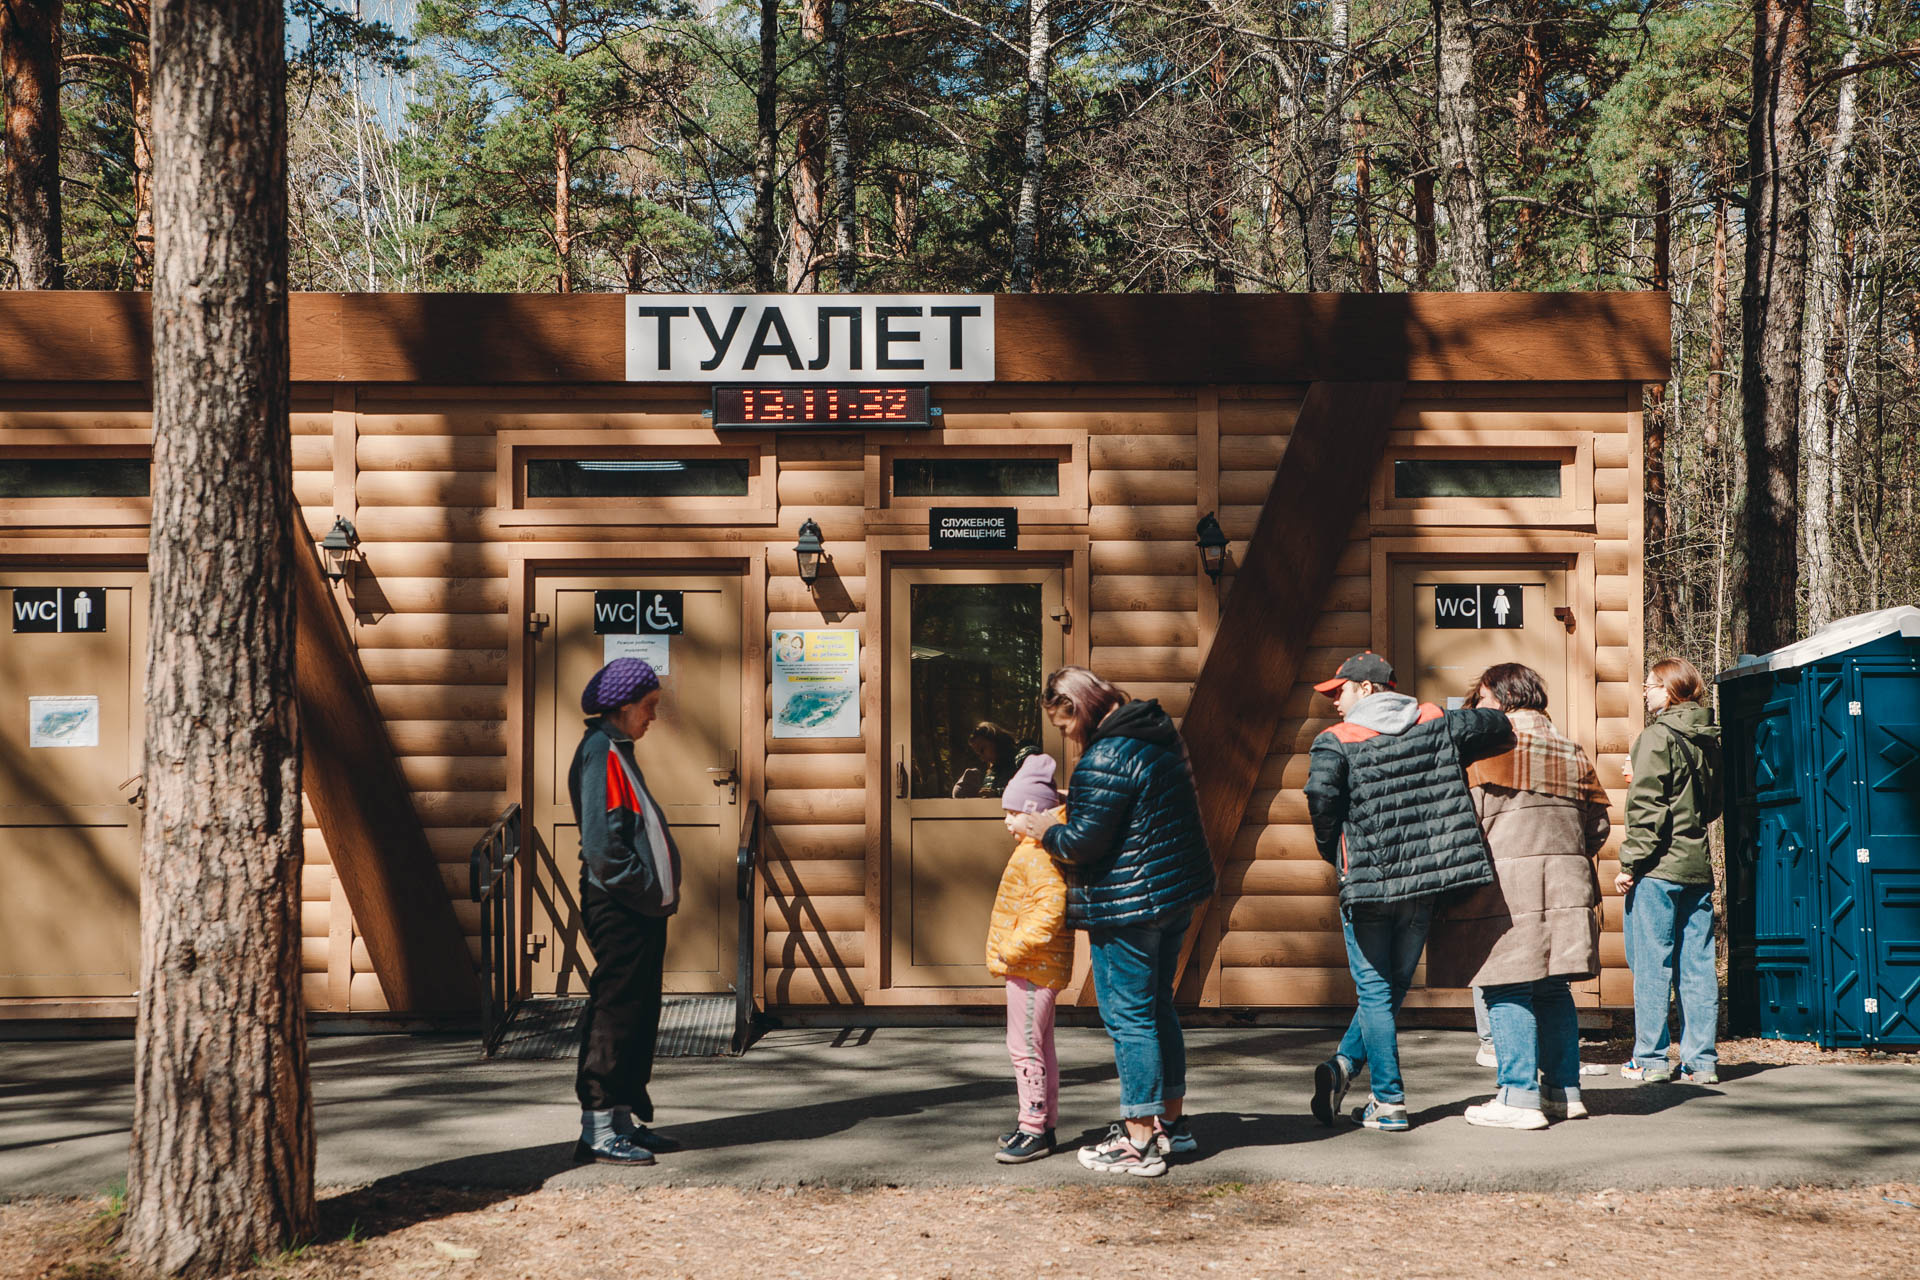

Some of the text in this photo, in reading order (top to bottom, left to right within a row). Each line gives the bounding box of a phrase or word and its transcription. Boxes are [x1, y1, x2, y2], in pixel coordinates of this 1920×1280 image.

[638, 306, 982, 371] ТУАЛЕТ
[743, 389, 907, 420] 13:11:32
[941, 518, 1005, 527] СЛУЖЕБНОЕ
[940, 529, 1007, 539] ПОМЕЩЕНИЕ
[14, 601, 57, 621] WC
[595, 603, 636, 622] WC
[1436, 598, 1477, 617] WC
